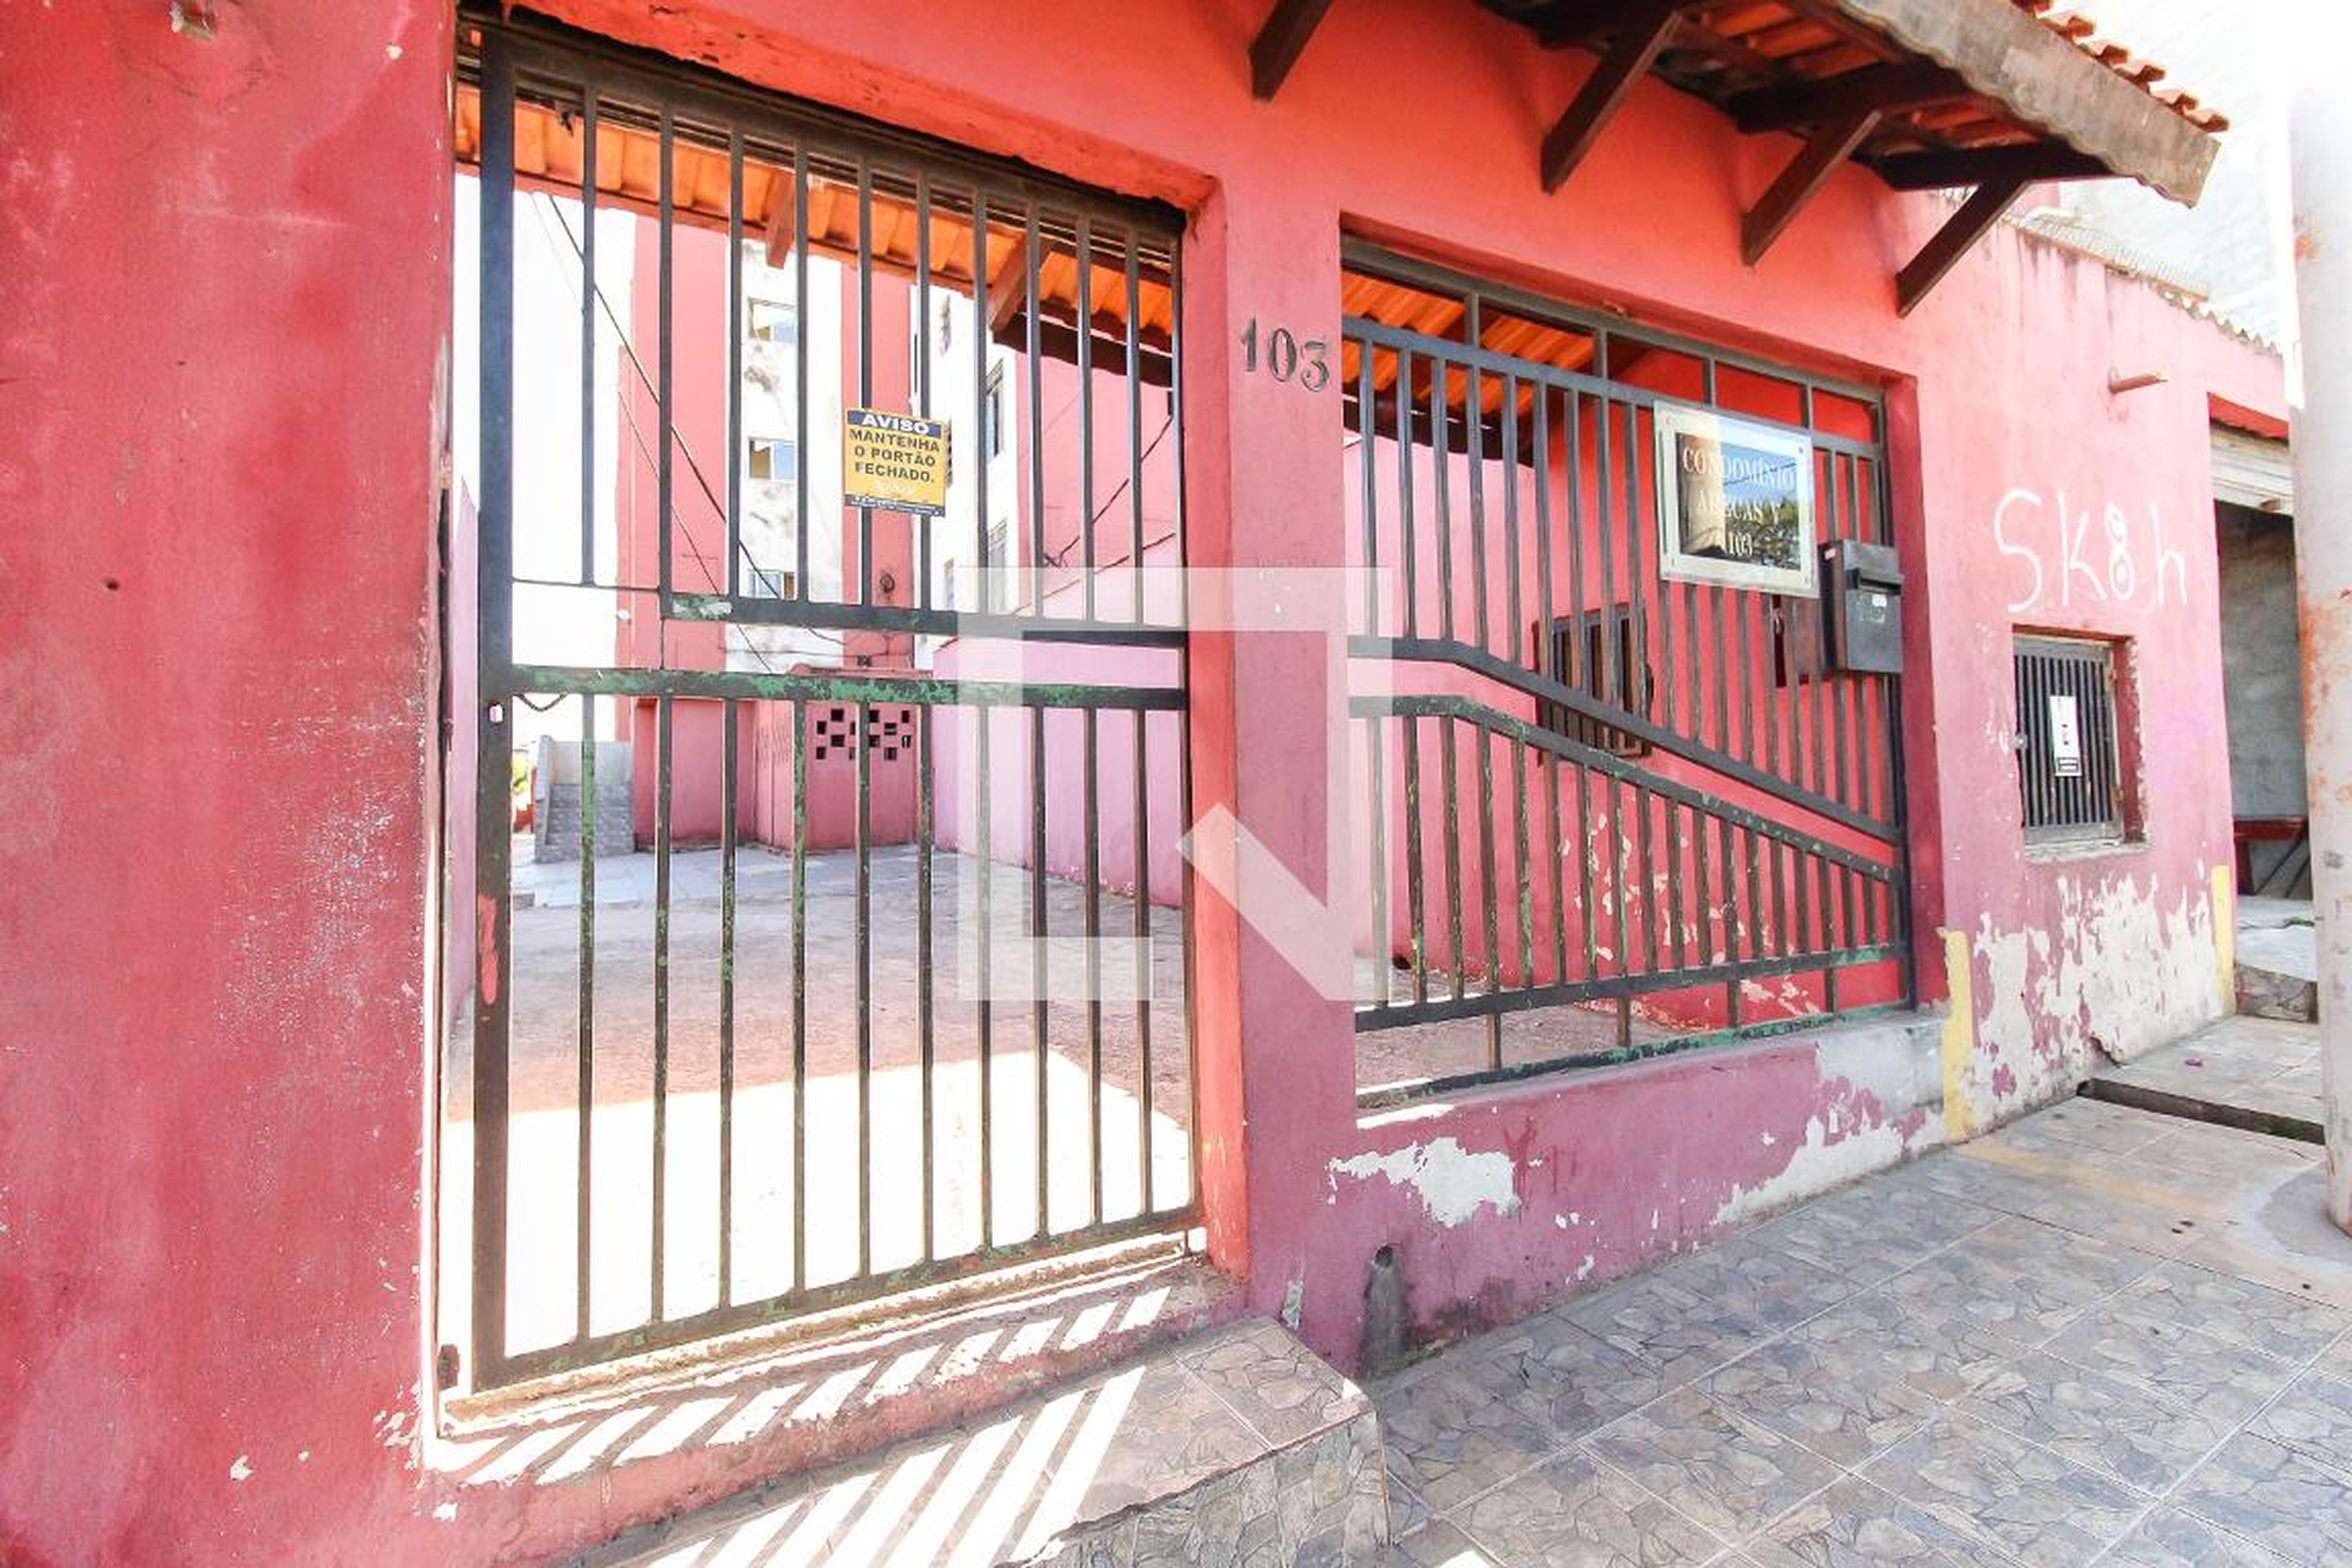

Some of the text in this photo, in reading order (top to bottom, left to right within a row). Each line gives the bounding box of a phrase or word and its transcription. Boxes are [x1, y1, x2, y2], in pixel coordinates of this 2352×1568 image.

[1240, 314, 1330, 393] 103
[861, 414, 930, 434] AVISO
[850, 429, 940, 453] MANTENHA
[854, 445, 936, 467] O PORTÃO
[854, 462, 935, 483] FECHADO.
